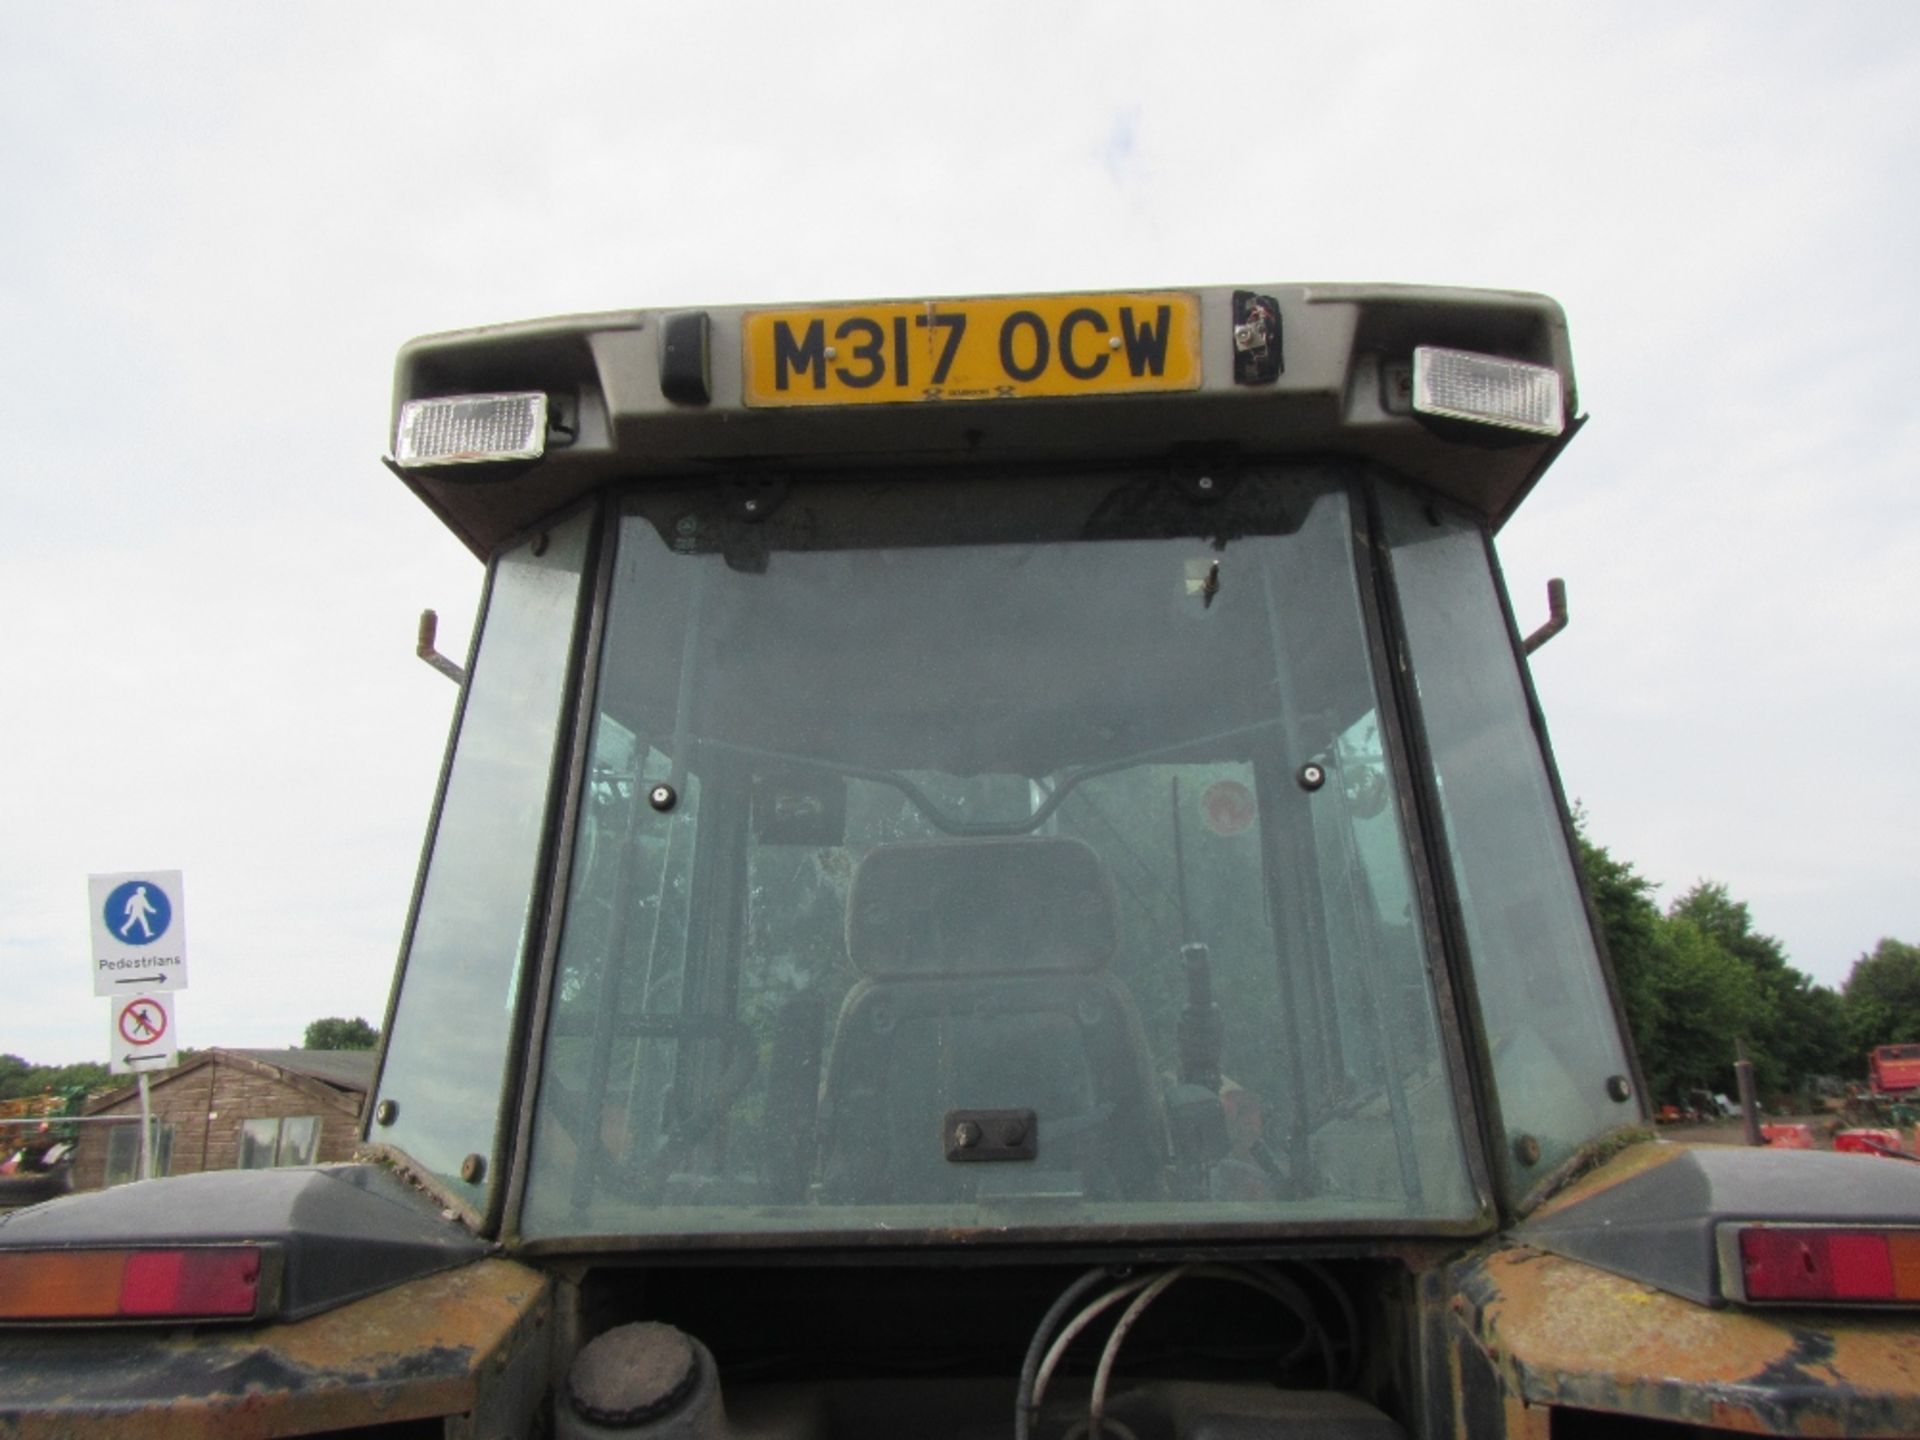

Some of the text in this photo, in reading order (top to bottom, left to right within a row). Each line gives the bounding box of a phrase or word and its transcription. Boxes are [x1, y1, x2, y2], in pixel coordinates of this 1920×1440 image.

[773, 305, 1171, 391] M317 OCW
[99, 956, 181, 970] Pedestrians
